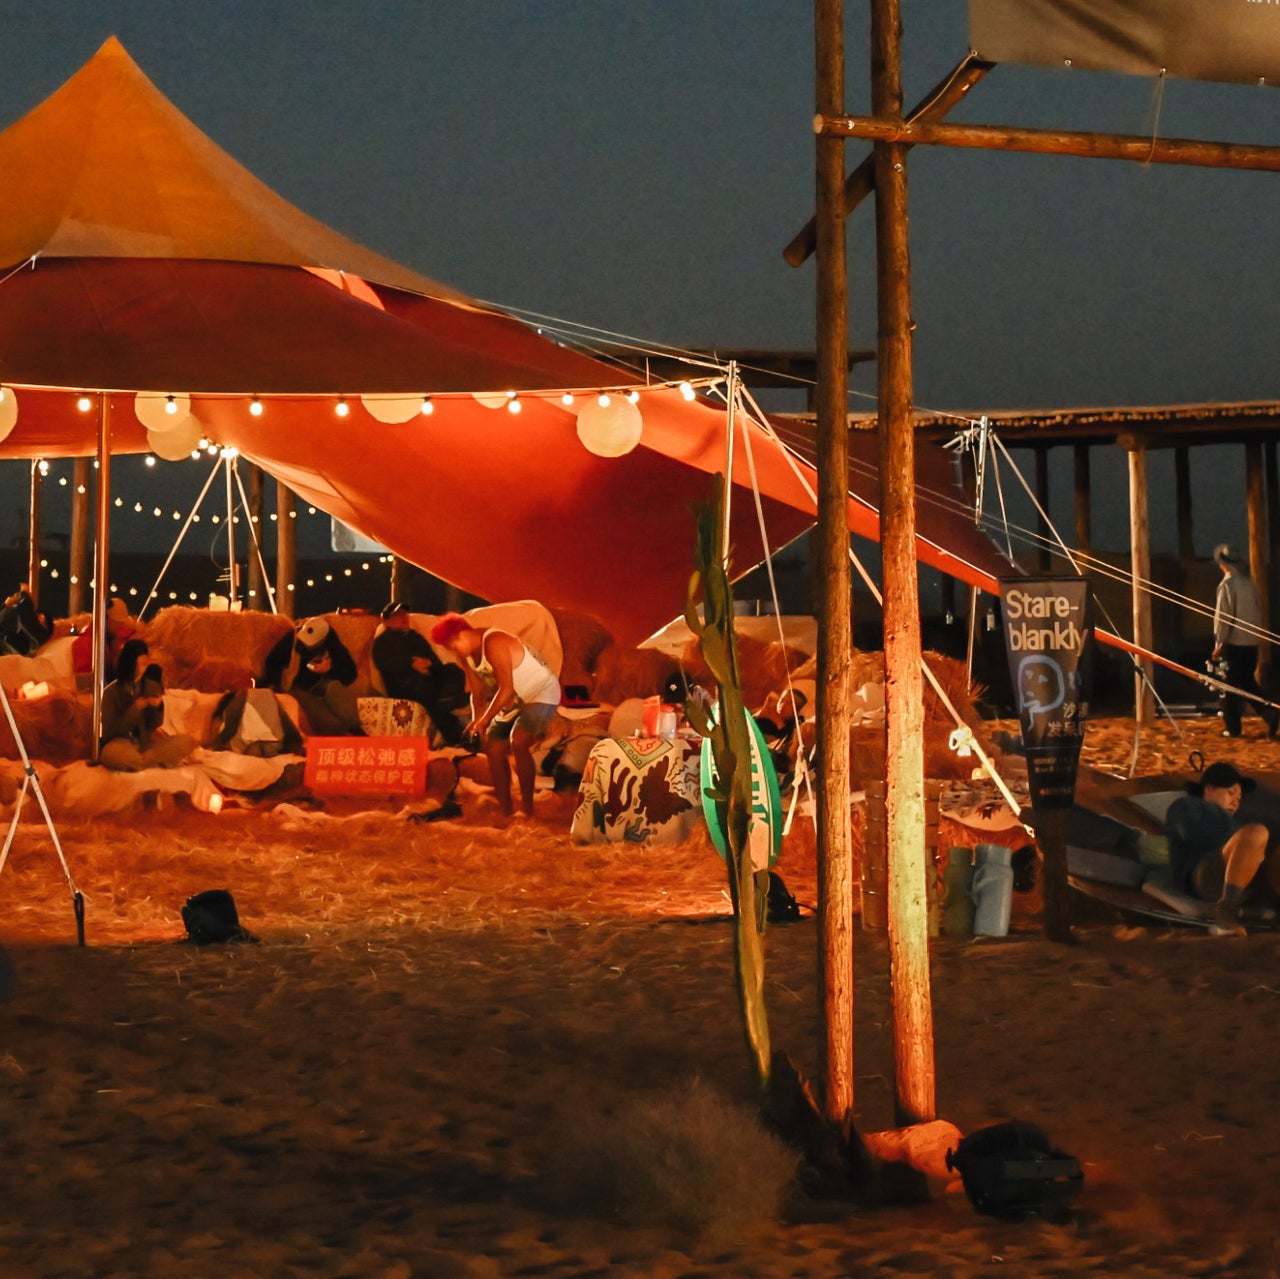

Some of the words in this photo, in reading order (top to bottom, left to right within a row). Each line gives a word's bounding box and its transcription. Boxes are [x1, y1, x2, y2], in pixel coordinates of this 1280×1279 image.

[1006, 589, 1079, 619] Stare-
[1008, 621, 1089, 657] blankly
[317, 747, 416, 766] 顶级松弛感
